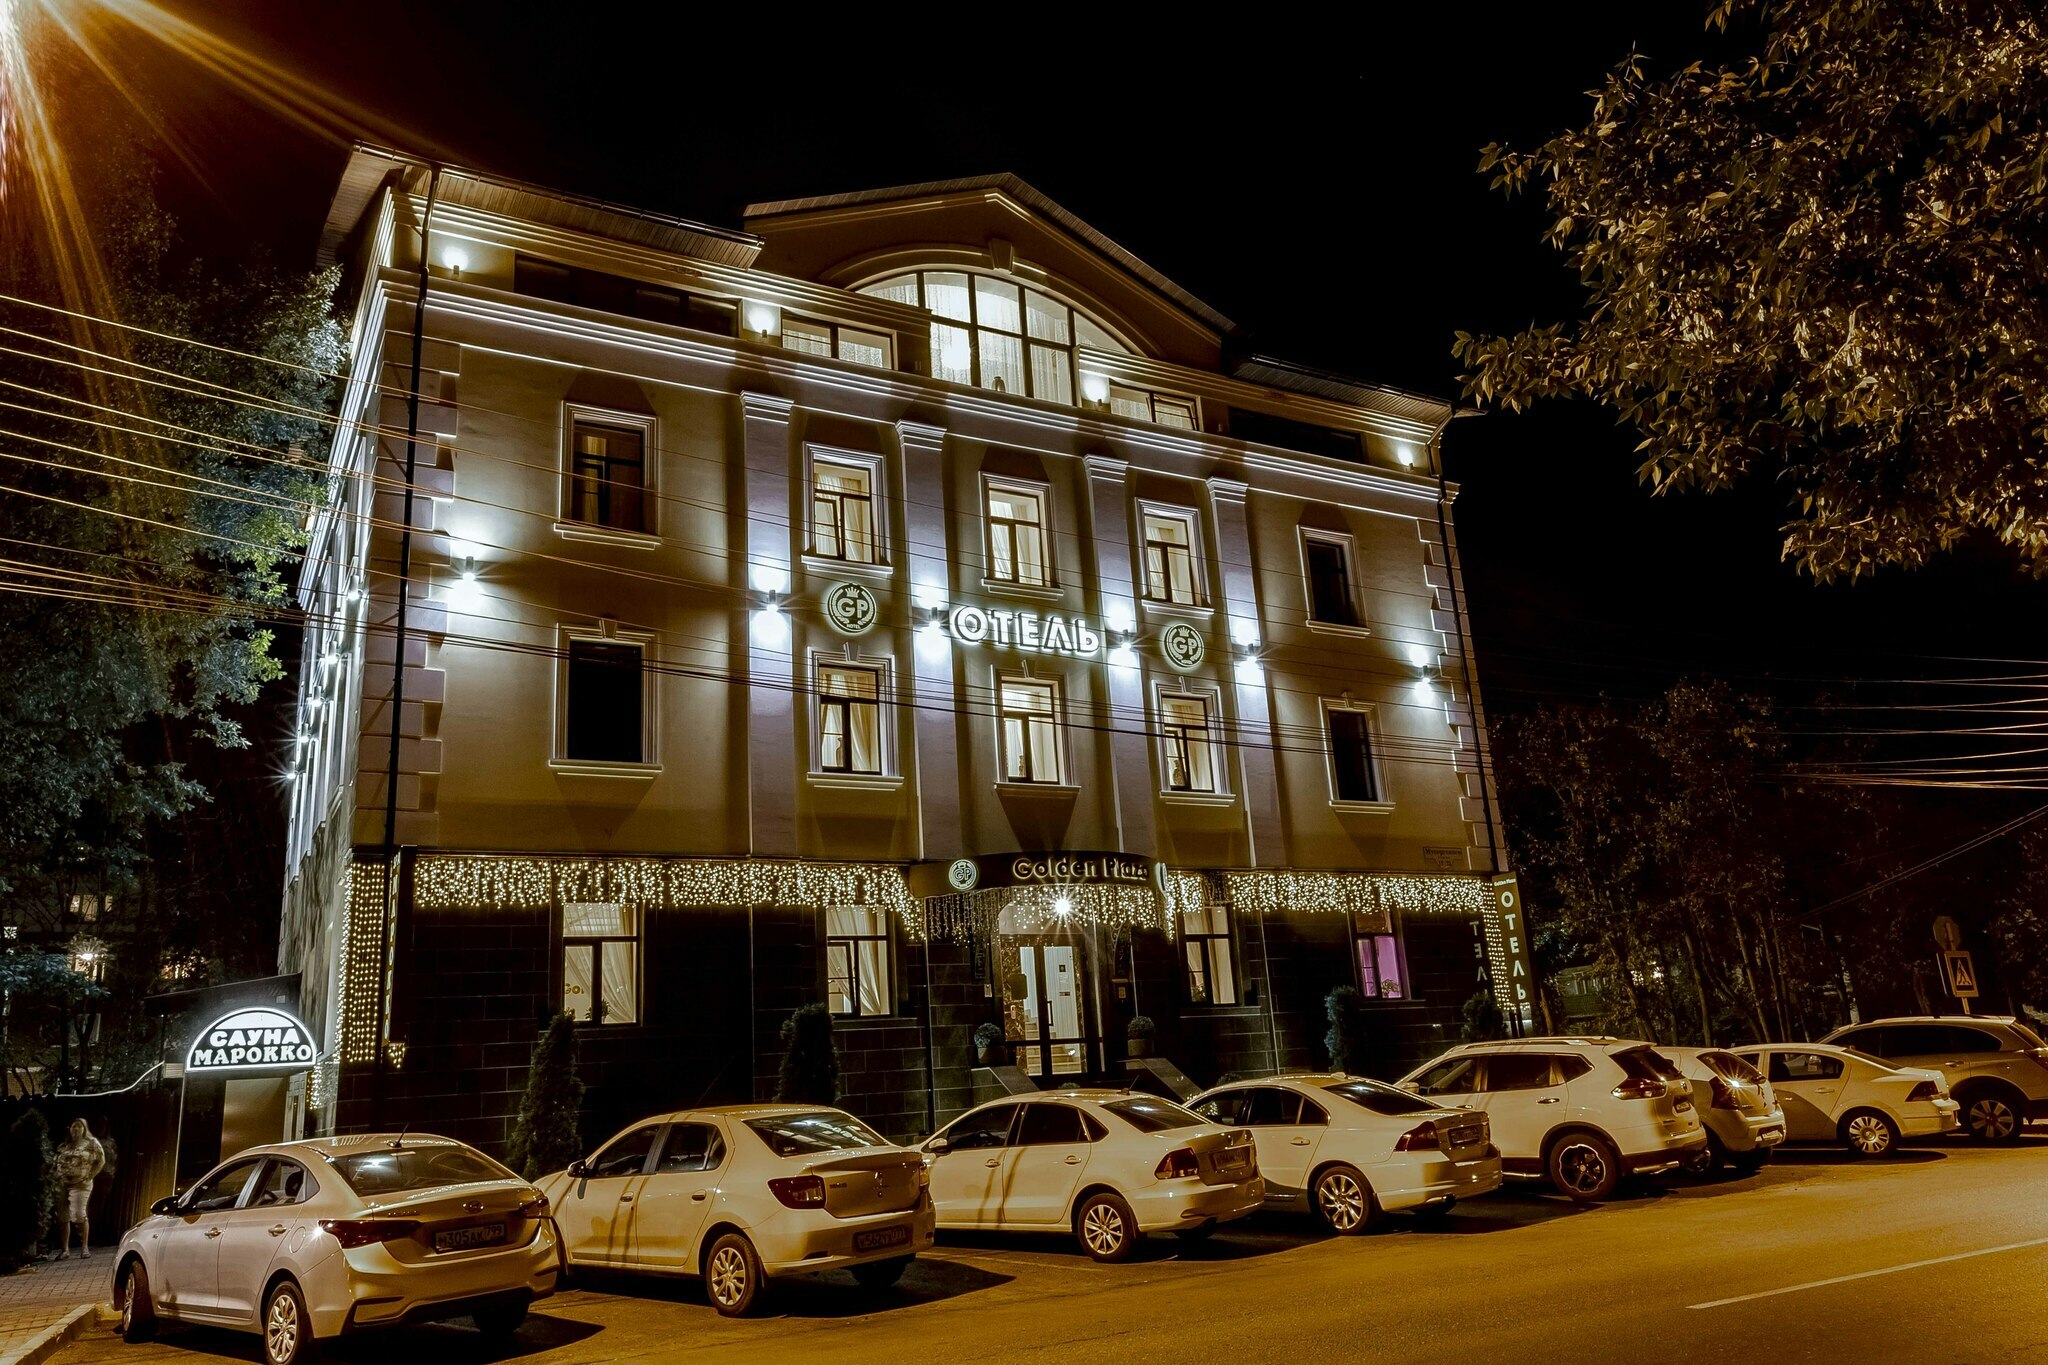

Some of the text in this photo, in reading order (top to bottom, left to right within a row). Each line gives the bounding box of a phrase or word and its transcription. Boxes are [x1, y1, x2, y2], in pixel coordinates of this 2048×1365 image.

[837, 598, 868, 618] GP
[952, 606, 1100, 654] ОТЕЛЬ
[1173, 636, 1197, 655] GP
[1013, 857, 1097, 879] Golden
[1501, 891, 1526, 1000] ОТЕЛЬ
[210, 1028, 300, 1047] САУНА
[194, 1044, 312, 1065] МАРОККО
